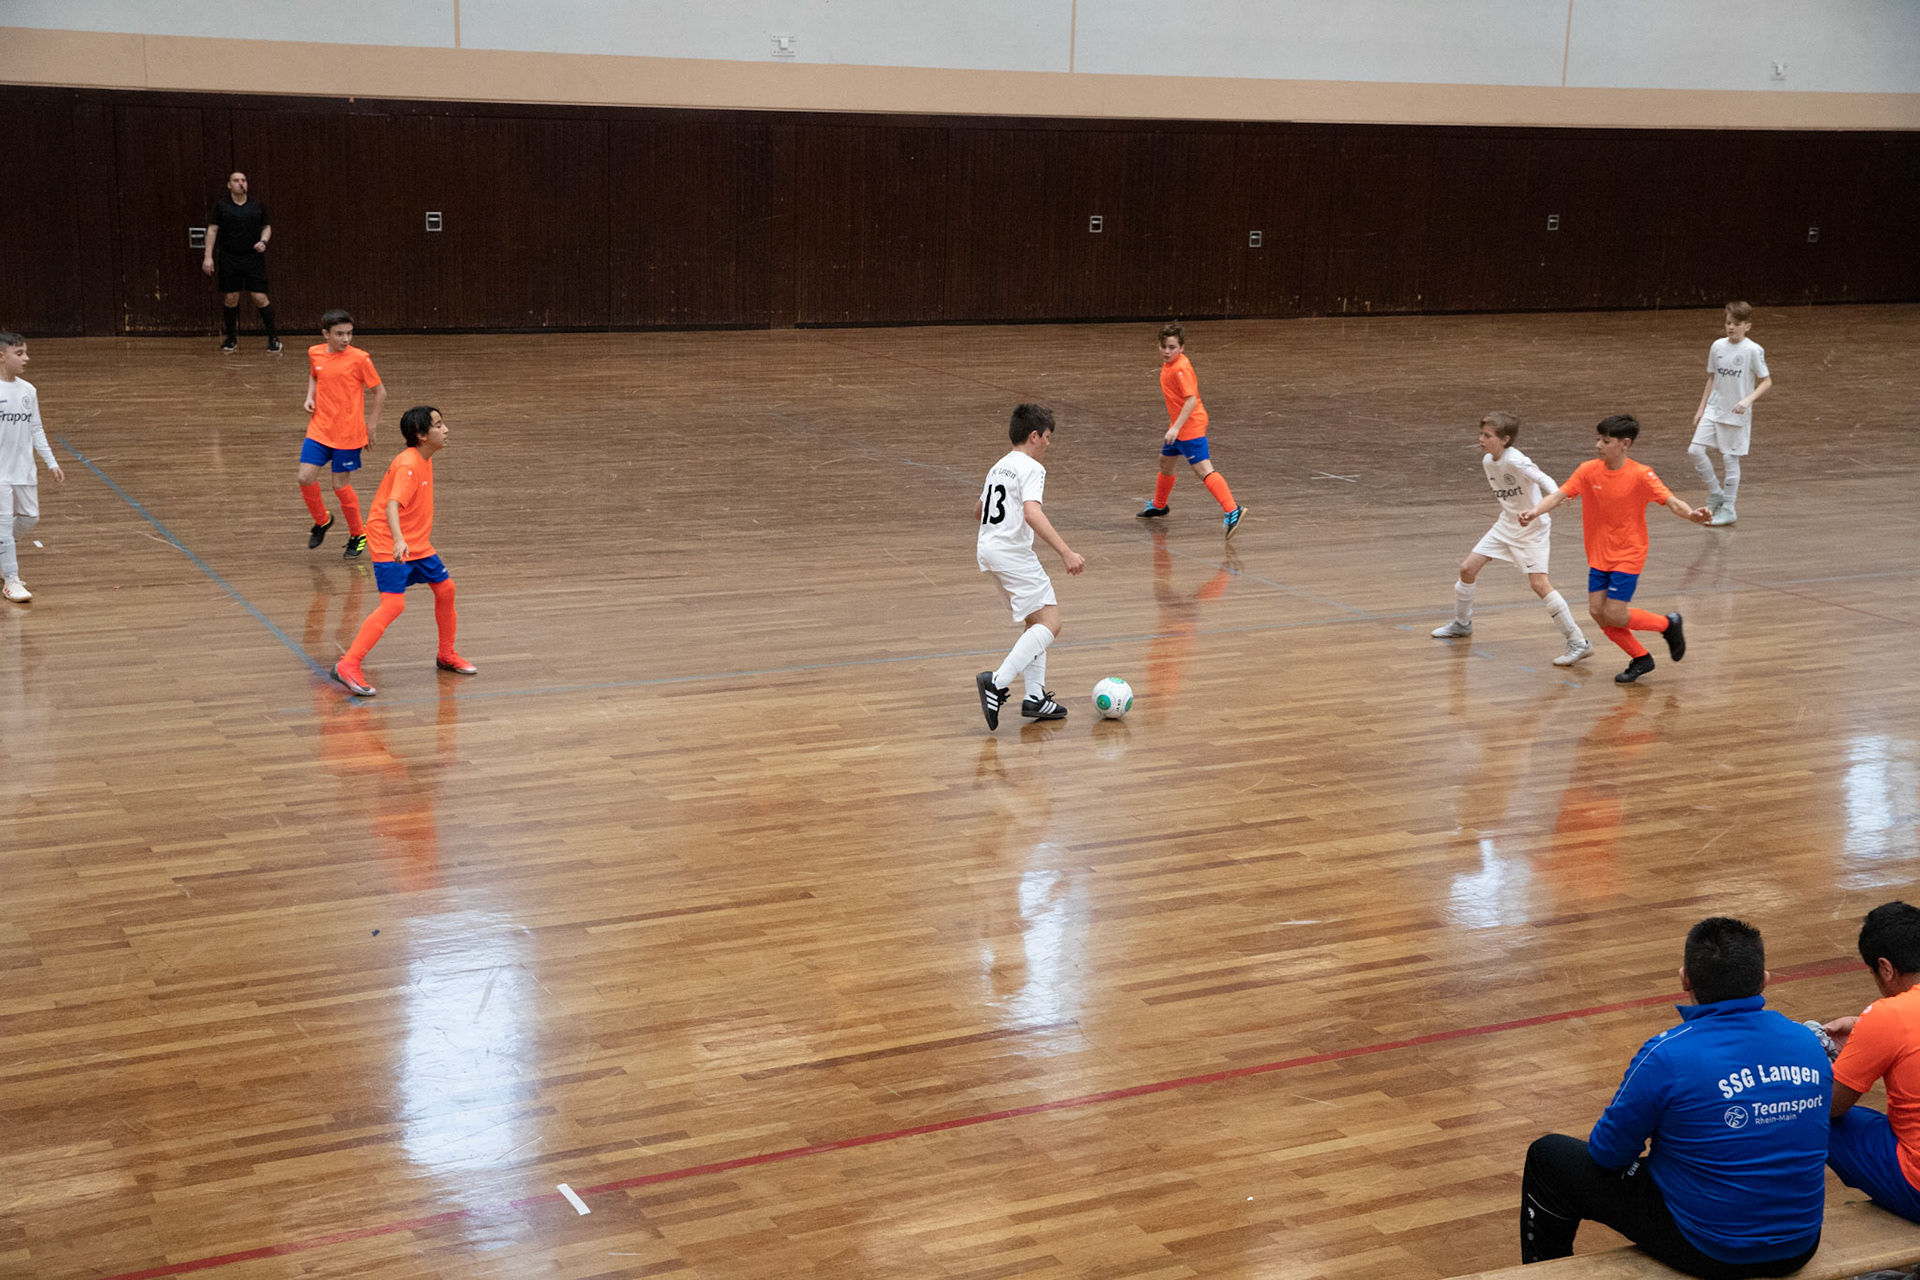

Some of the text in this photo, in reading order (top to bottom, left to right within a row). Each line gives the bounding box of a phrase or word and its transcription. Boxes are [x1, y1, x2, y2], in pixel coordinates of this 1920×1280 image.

[982, 484, 1006, 525] 13
[1718, 1064, 1820, 1099] SSG Langen
[1752, 1094, 1823, 1117] Teamsport
[1755, 1113, 1797, 1125] Rhein-Main
